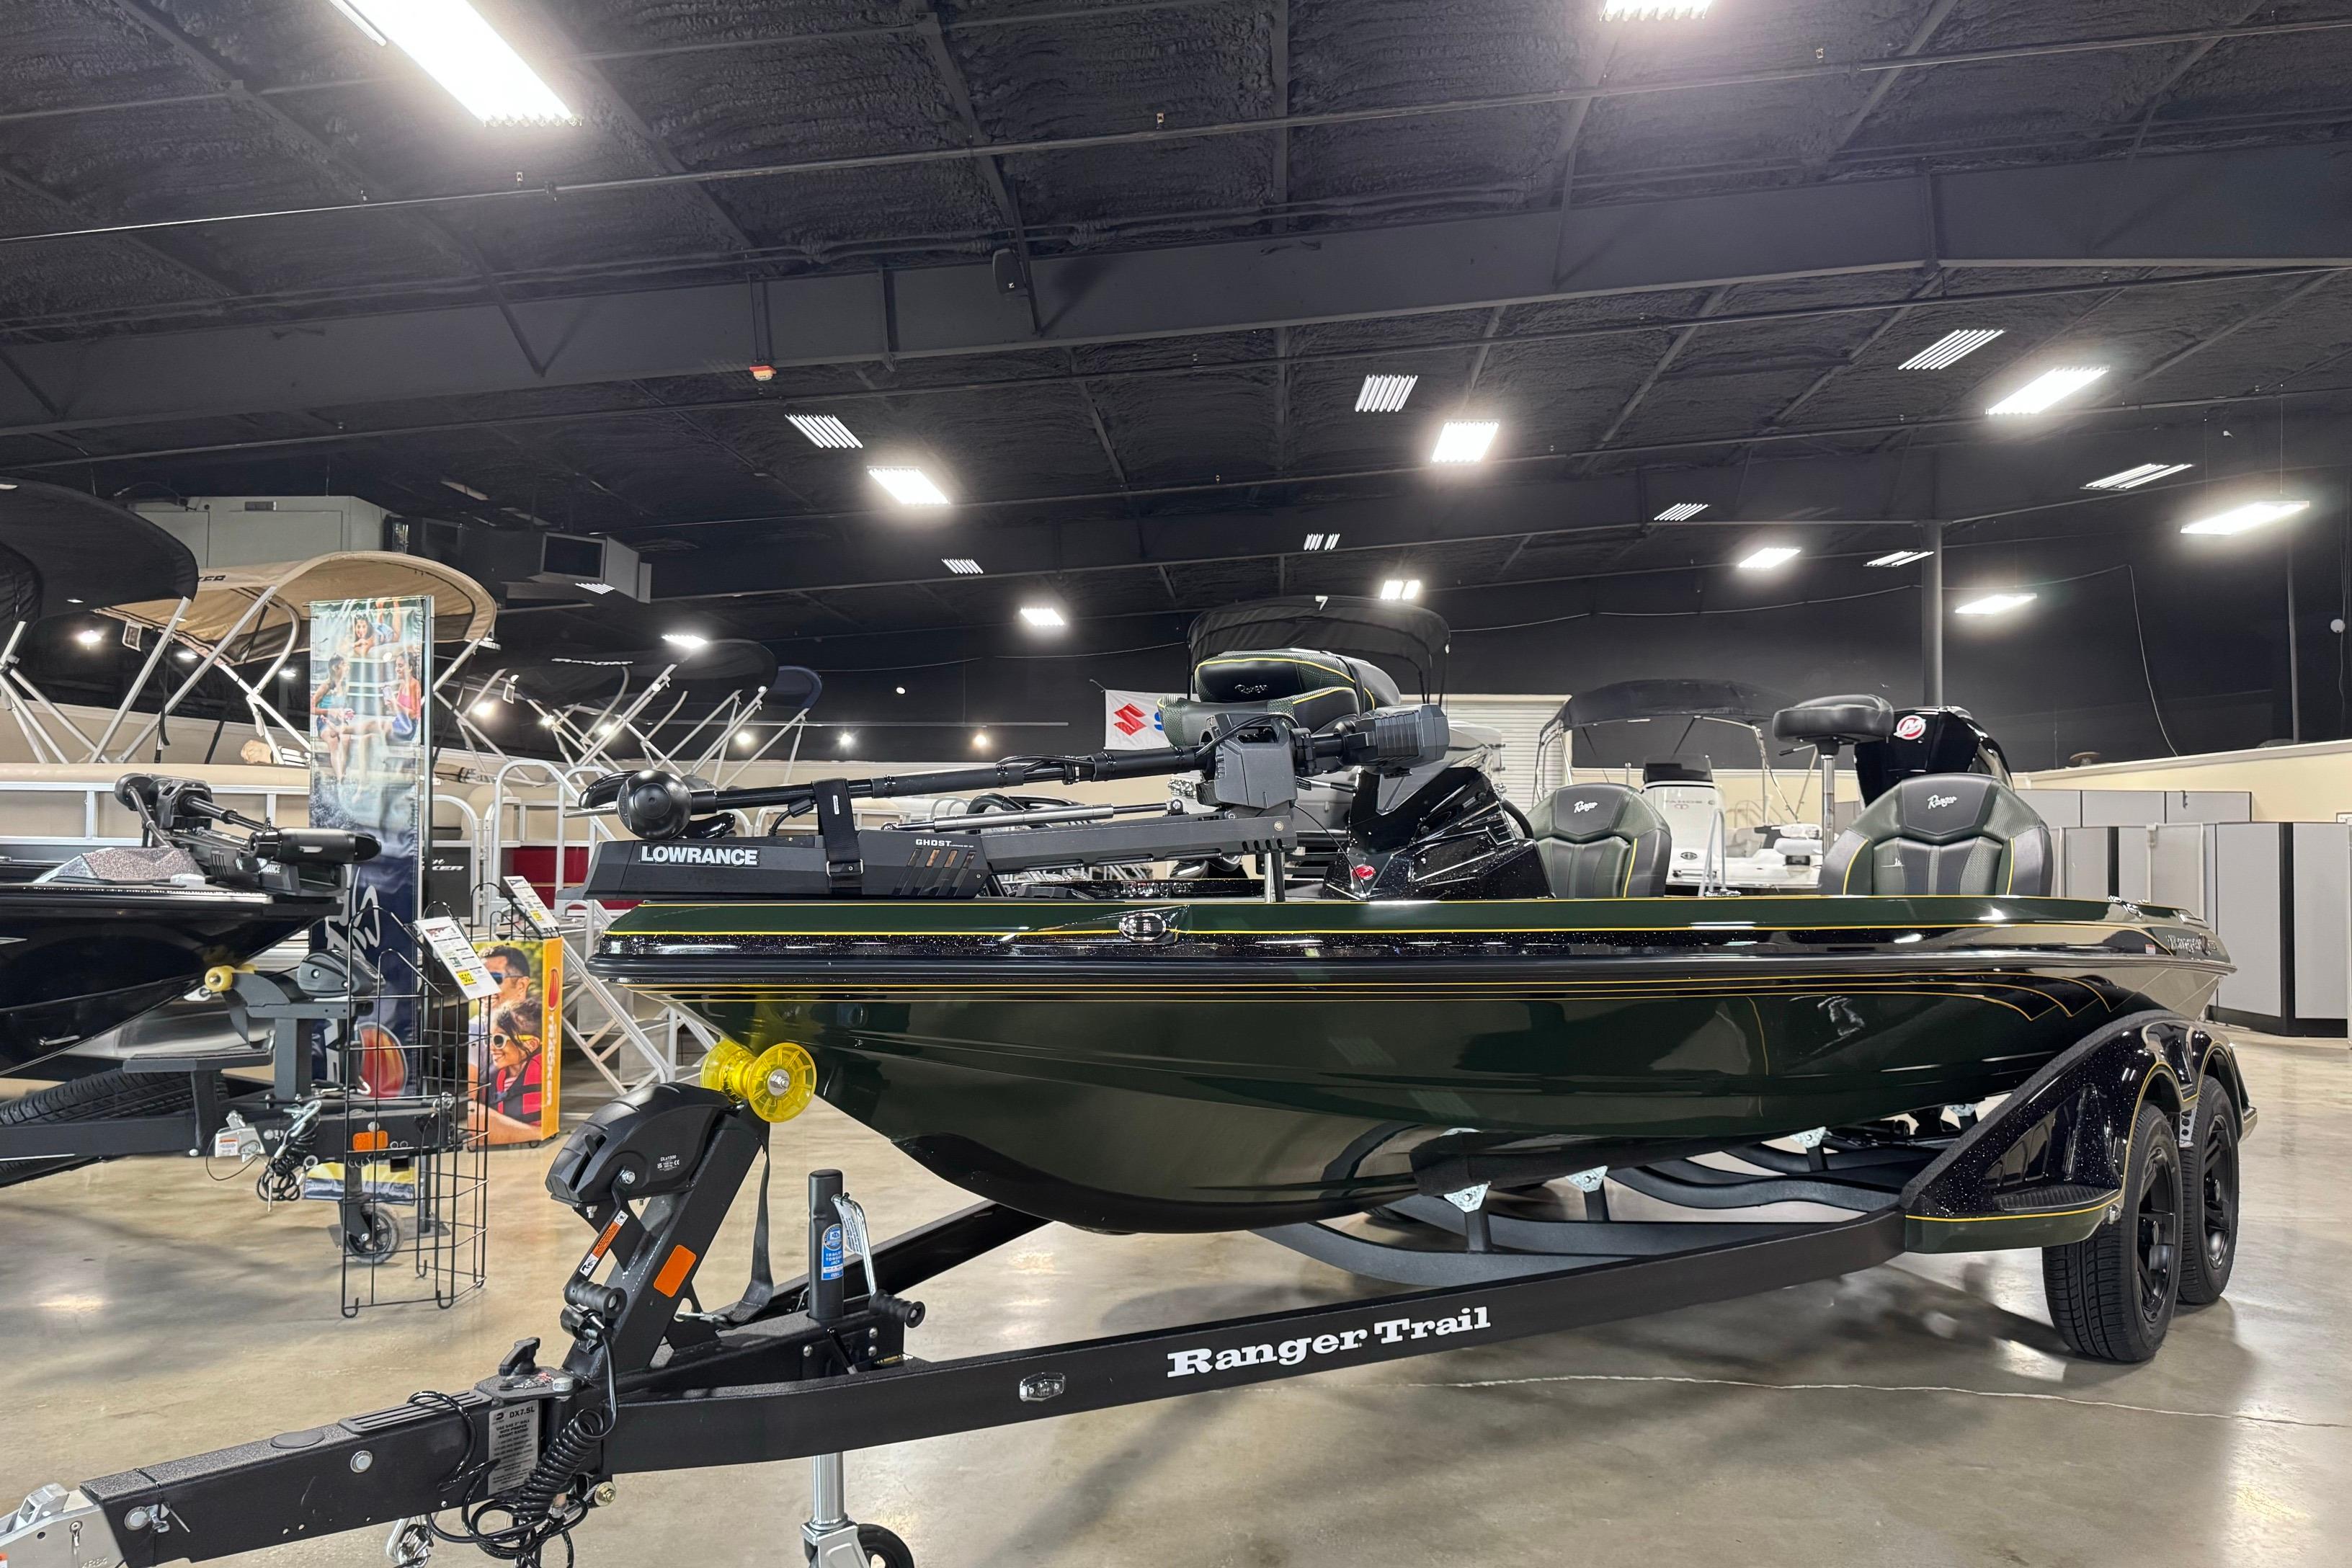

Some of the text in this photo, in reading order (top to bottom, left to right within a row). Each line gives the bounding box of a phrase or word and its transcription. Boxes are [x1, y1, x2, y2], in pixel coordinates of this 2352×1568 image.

[1573, 801, 1598, 814] Ranger
[1927, 794, 1957, 809] Ranger
[915, 838, 952, 847] GHOST
[641, 845, 759, 866] LOWRANCE
[1121, 881, 1194, 897] Ranger
[1167, 1306, 1491, 1378] Ranger Trail
[509, 1406, 535, 1418] DX7.5L
